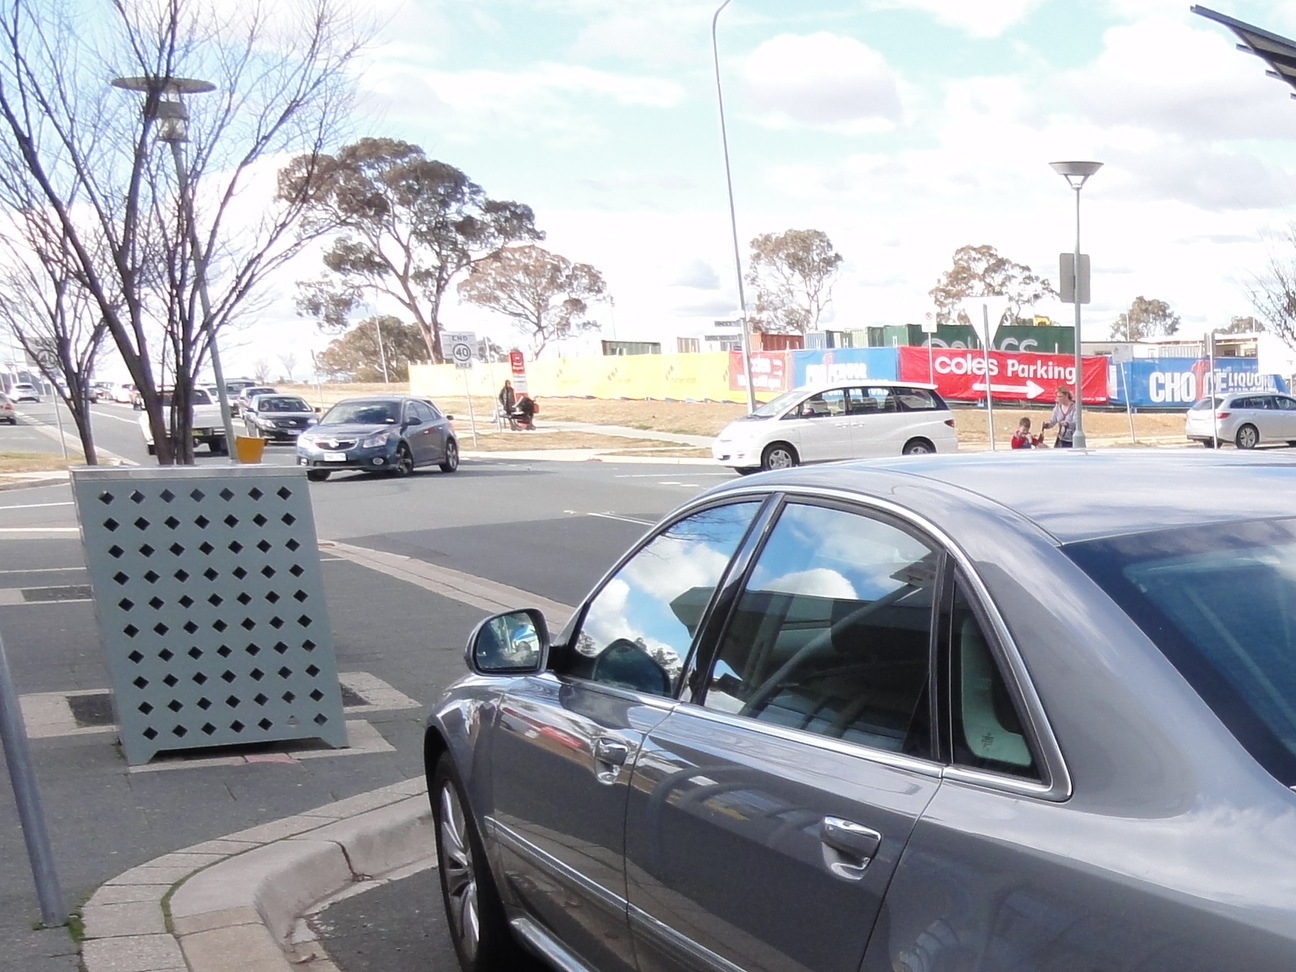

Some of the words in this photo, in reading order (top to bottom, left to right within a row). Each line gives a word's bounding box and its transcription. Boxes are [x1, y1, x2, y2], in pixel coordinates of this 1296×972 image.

[455, 347, 469, 358] 40
[934, 353, 999, 376] coles
[1006, 359, 1078, 385] Parking
